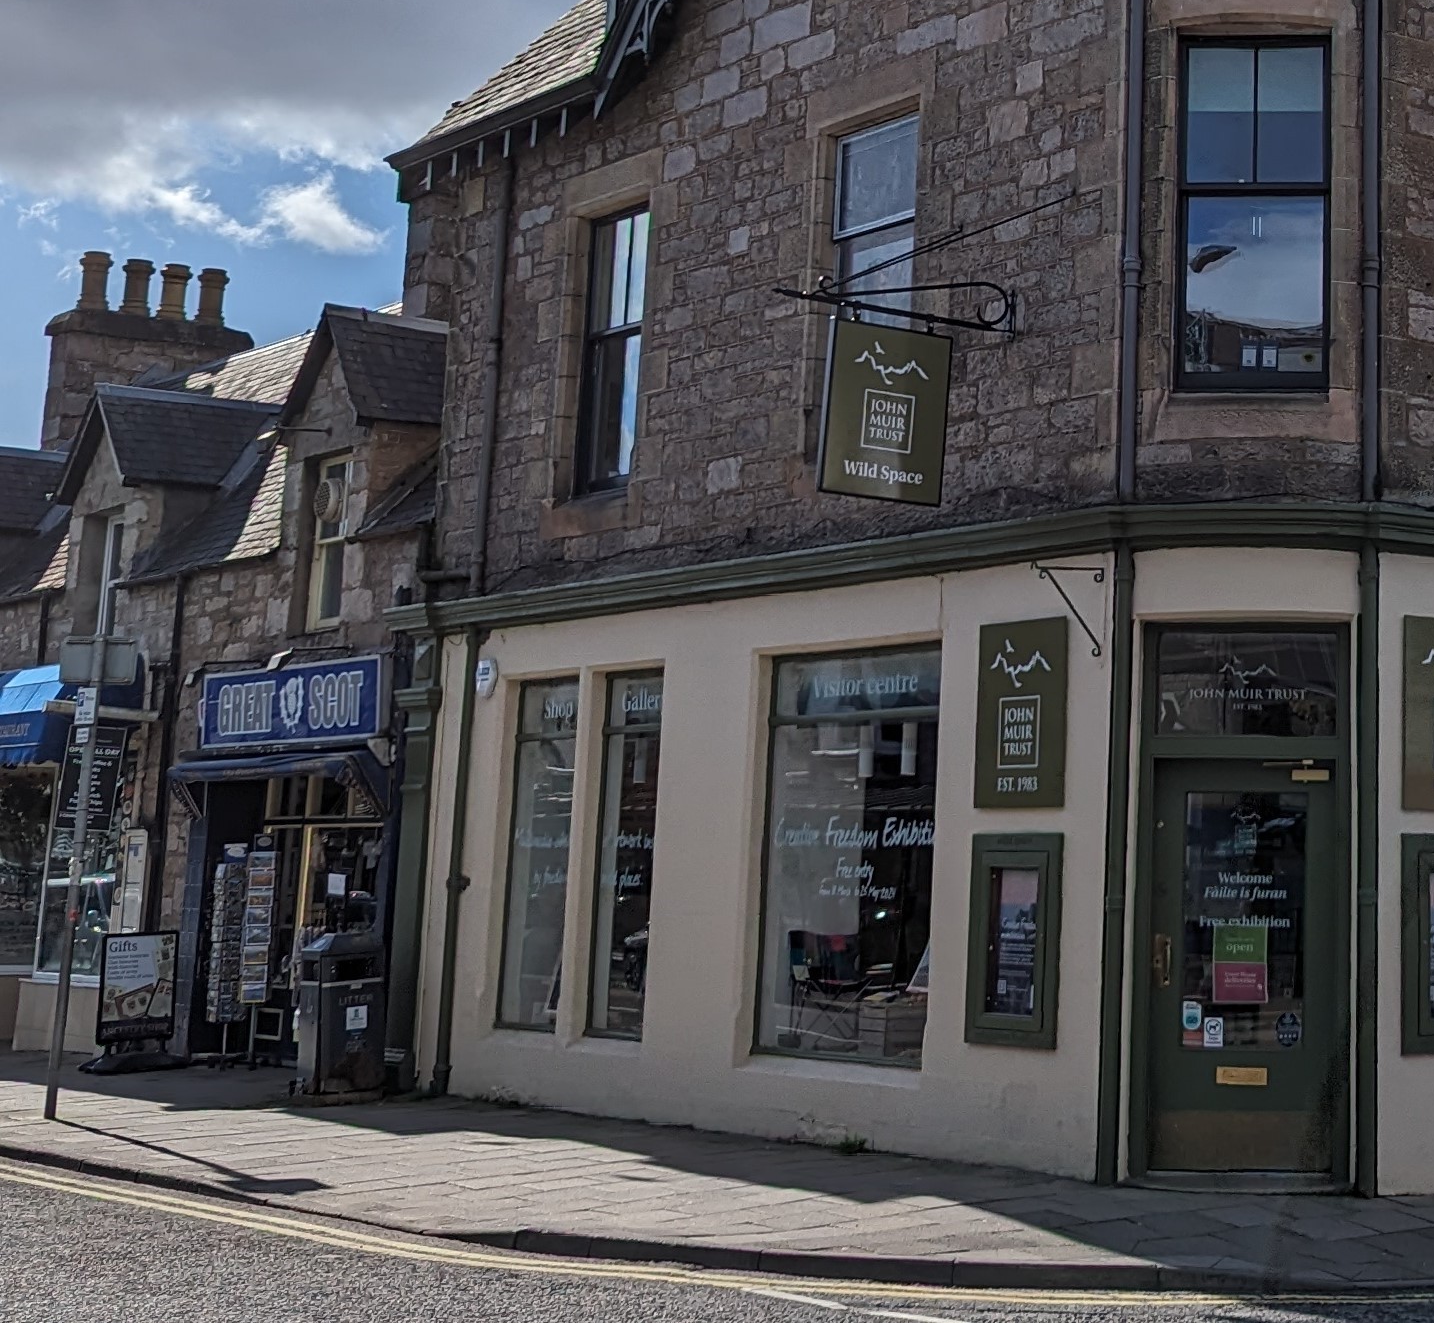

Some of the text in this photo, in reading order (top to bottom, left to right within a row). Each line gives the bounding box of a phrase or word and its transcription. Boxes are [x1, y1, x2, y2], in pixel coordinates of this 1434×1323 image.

[870, 398, 908, 416] JOHN
[869, 413, 906, 430] MUIR
[869, 427, 906, 443] TRUST
[843, 459, 924, 485] Wild Space
[814, 673, 919, 698] Visitor centre
[1189, 688, 1307, 700] JOHN MUIR TRUST
[218, 671, 364, 736] GREAT SCOT
[543, 697, 574, 720] Shop
[1004, 706, 1035, 725] JOHN
[1003, 724, 1034, 740] MUIR
[1003, 741, 1034, 757] TRUST
[997, 776, 1039, 793] EST. 1983
[825, 814, 879, 848] Freedom
[836, 856, 875, 888] Free entry
[1218, 871, 1273, 884] Welcome
[1240, 886, 1250, 899] is
[1249, 886, 1288, 902] furan
[1199, 914, 1291, 928] Free exhibition
[108, 940, 138, 953] Gifts
[1225, 942, 1254, 955] open
[339, 993, 374, 1006] LITTER
